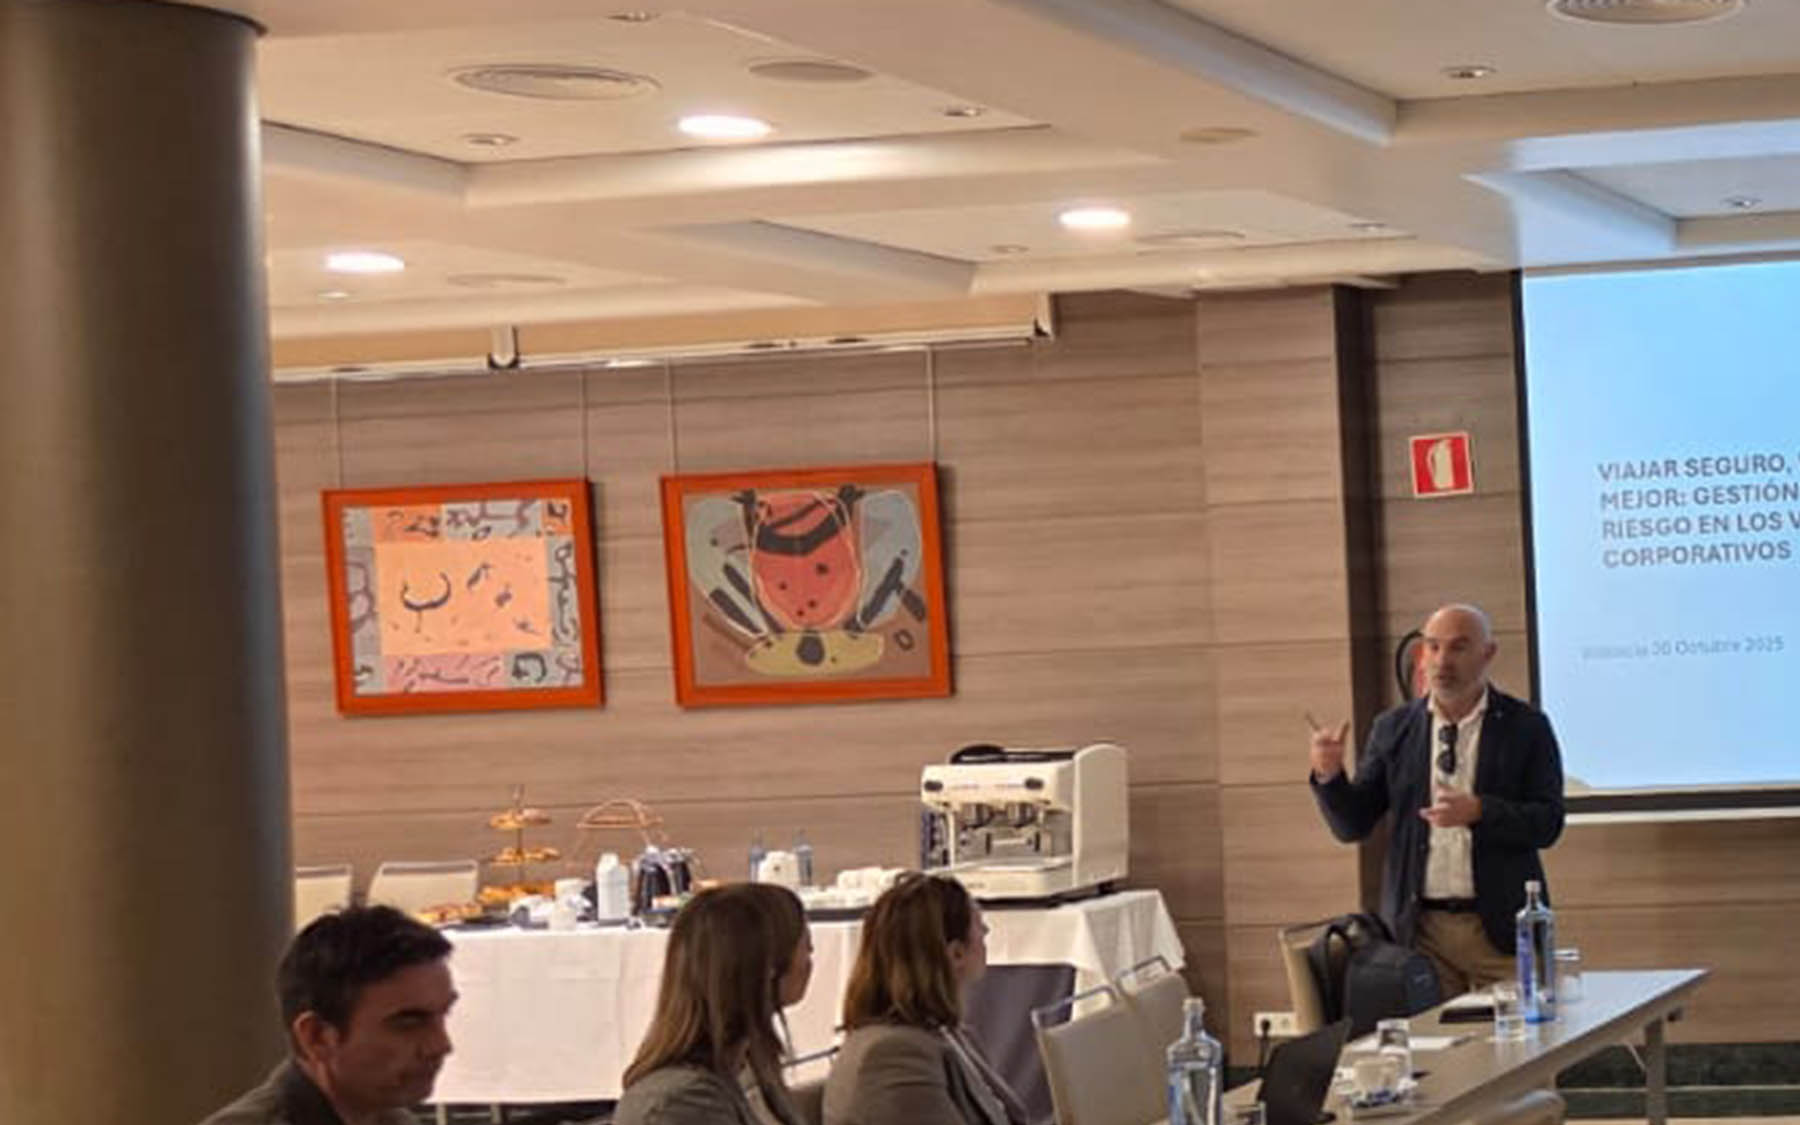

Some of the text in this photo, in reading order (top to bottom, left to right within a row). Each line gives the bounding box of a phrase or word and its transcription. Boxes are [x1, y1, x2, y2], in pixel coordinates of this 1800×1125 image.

[1598, 460, 1678, 482] VIAJAR
[1684, 454, 1794, 479] SEGURO,
[1601, 490, 1687, 511] MEJOR:
[1692, 480, 1799, 506] GESTIÓN
[1602, 517, 1692, 540] RIESGO
[1698, 515, 1730, 534] EN
[1736, 511, 1783, 532] LOS
[1602, 541, 1793, 569] CORPORATIVOS
